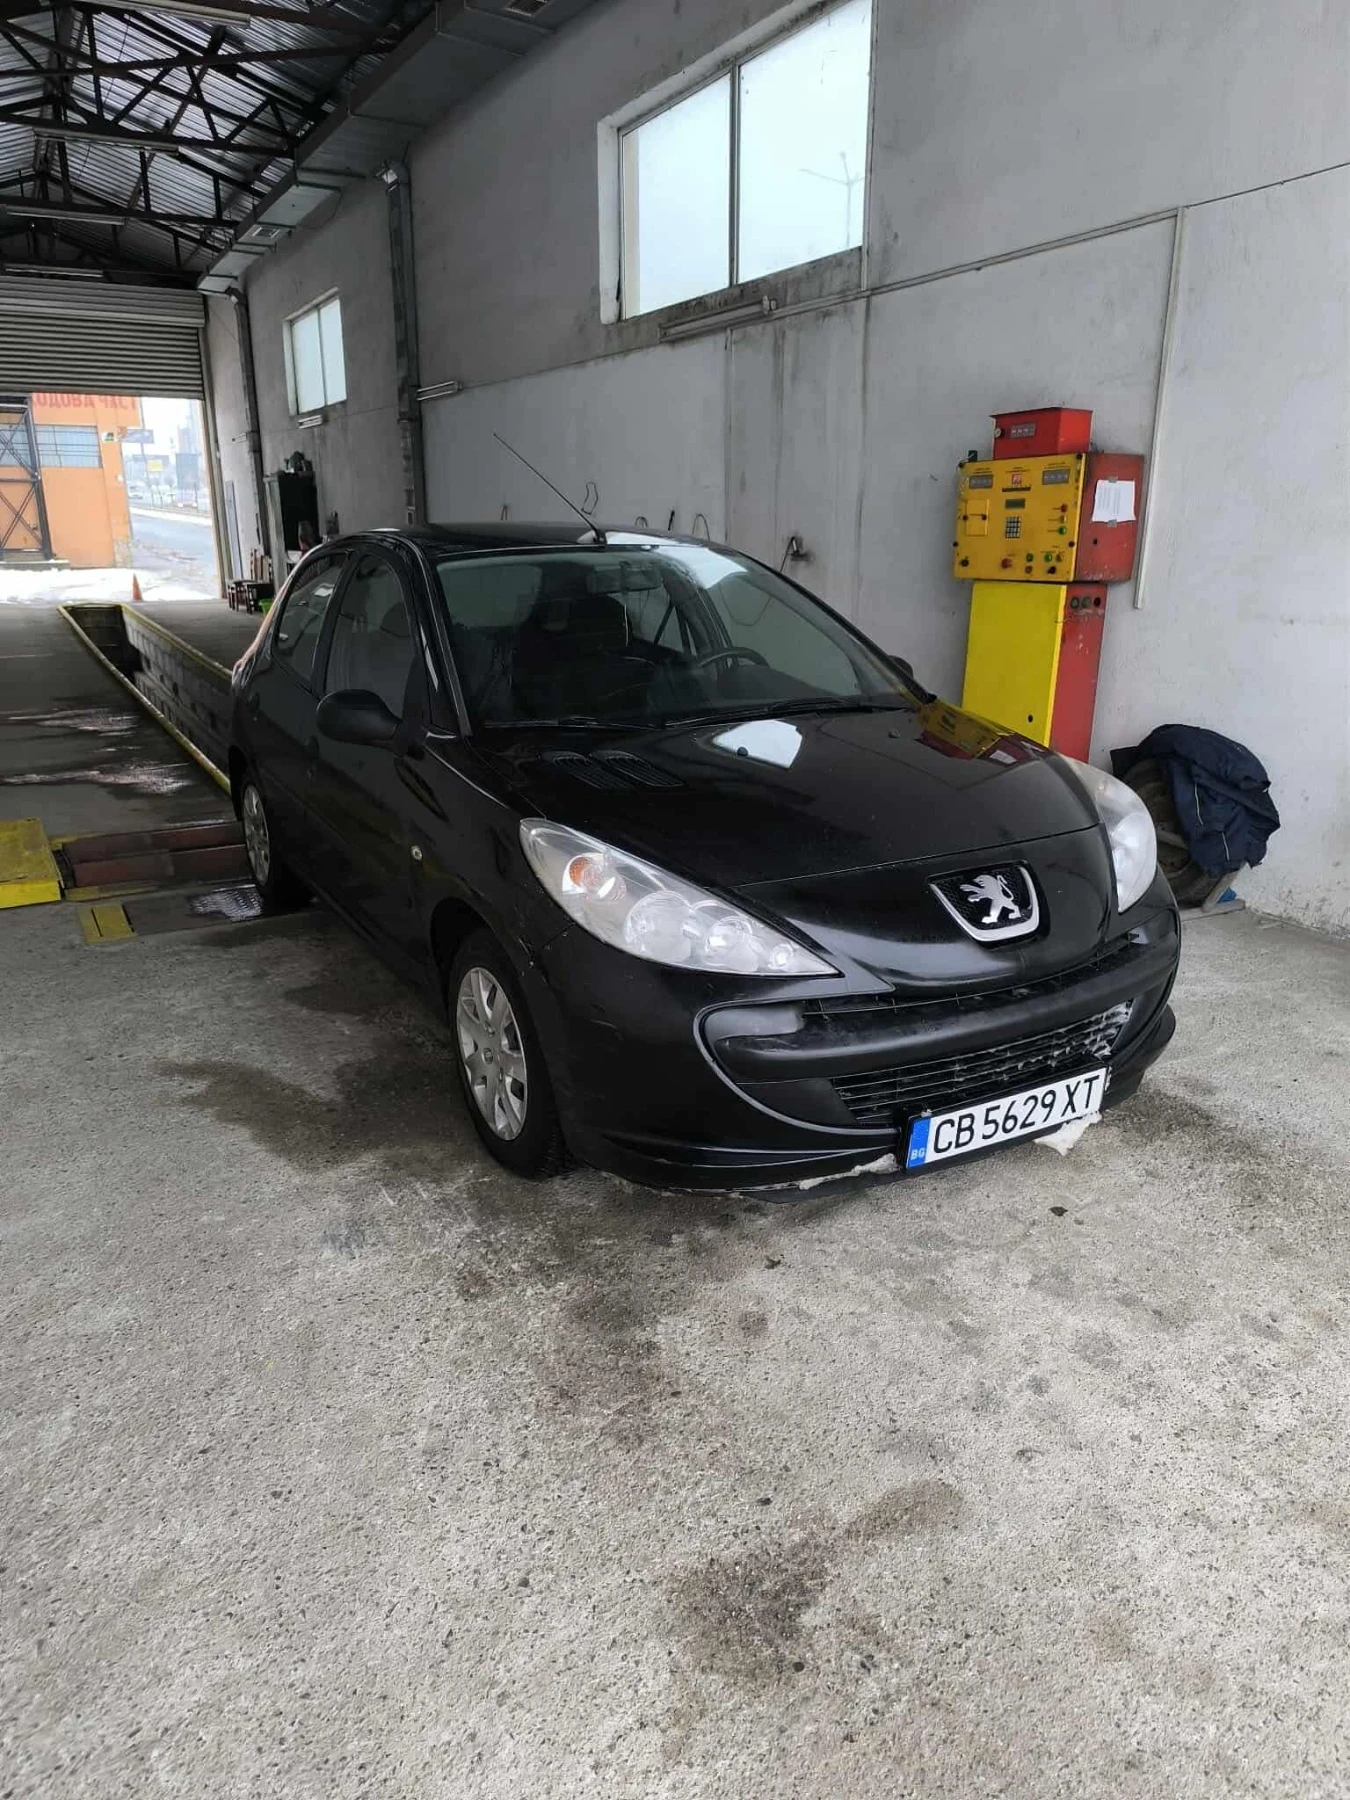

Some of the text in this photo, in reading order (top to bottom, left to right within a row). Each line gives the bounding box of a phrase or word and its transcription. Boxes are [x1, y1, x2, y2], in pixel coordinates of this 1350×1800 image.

[933, 1075, 1100, 1154] CB 5629 XT
[910, 1148, 925, 1161] BG
